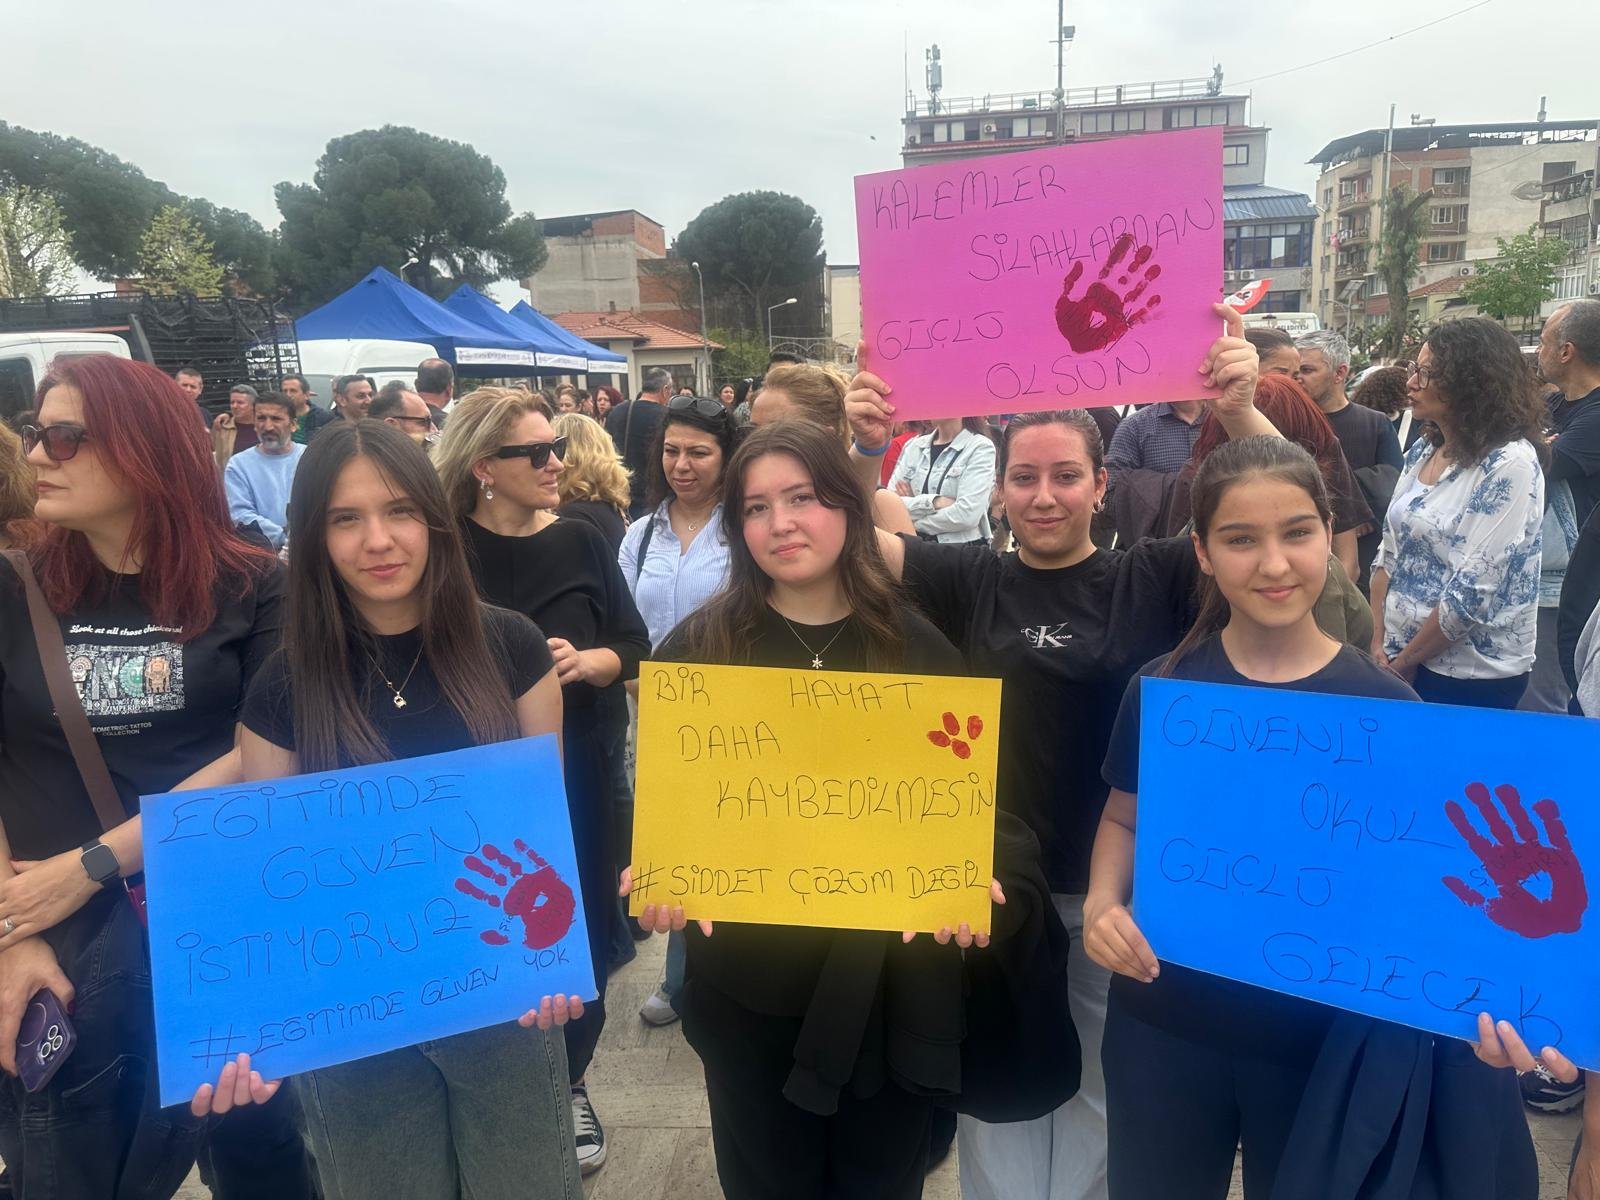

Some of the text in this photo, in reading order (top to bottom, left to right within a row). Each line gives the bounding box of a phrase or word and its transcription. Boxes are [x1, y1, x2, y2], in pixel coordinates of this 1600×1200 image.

[873, 165, 1066, 230] KALEMLER
[969, 198, 1215, 281] SİLAHLARDAN
[877, 311, 1004, 360] GÜÇLÜ
[986, 341, 1151, 399] OLSUN
[70, 624, 93, 633] Look
[106, 627, 119, 635] all
[120, 628, 142, 636] those
[653, 666, 924, 712] BİR HAYAT
[677, 721, 781, 762] DAHA
[1162, 694, 1380, 766] GÜVENLİ
[716, 771, 994, 824] KAYBEDİLMESİN
[1301, 782, 1457, 849] OKUL
[262, 810, 481, 899] GÜVEN
[789, 866, 894, 905] ÇÖZÜM
[907, 860, 989, 899] DEĞİL
[1160, 838, 1343, 907] GÜÇLÜ
[175, 898, 473, 996] İSTİYORUZ
[421, 964, 499, 1006] GÜVEN
[523, 944, 570, 972] YOK
[1262, 932, 1564, 1048] GELECEK
